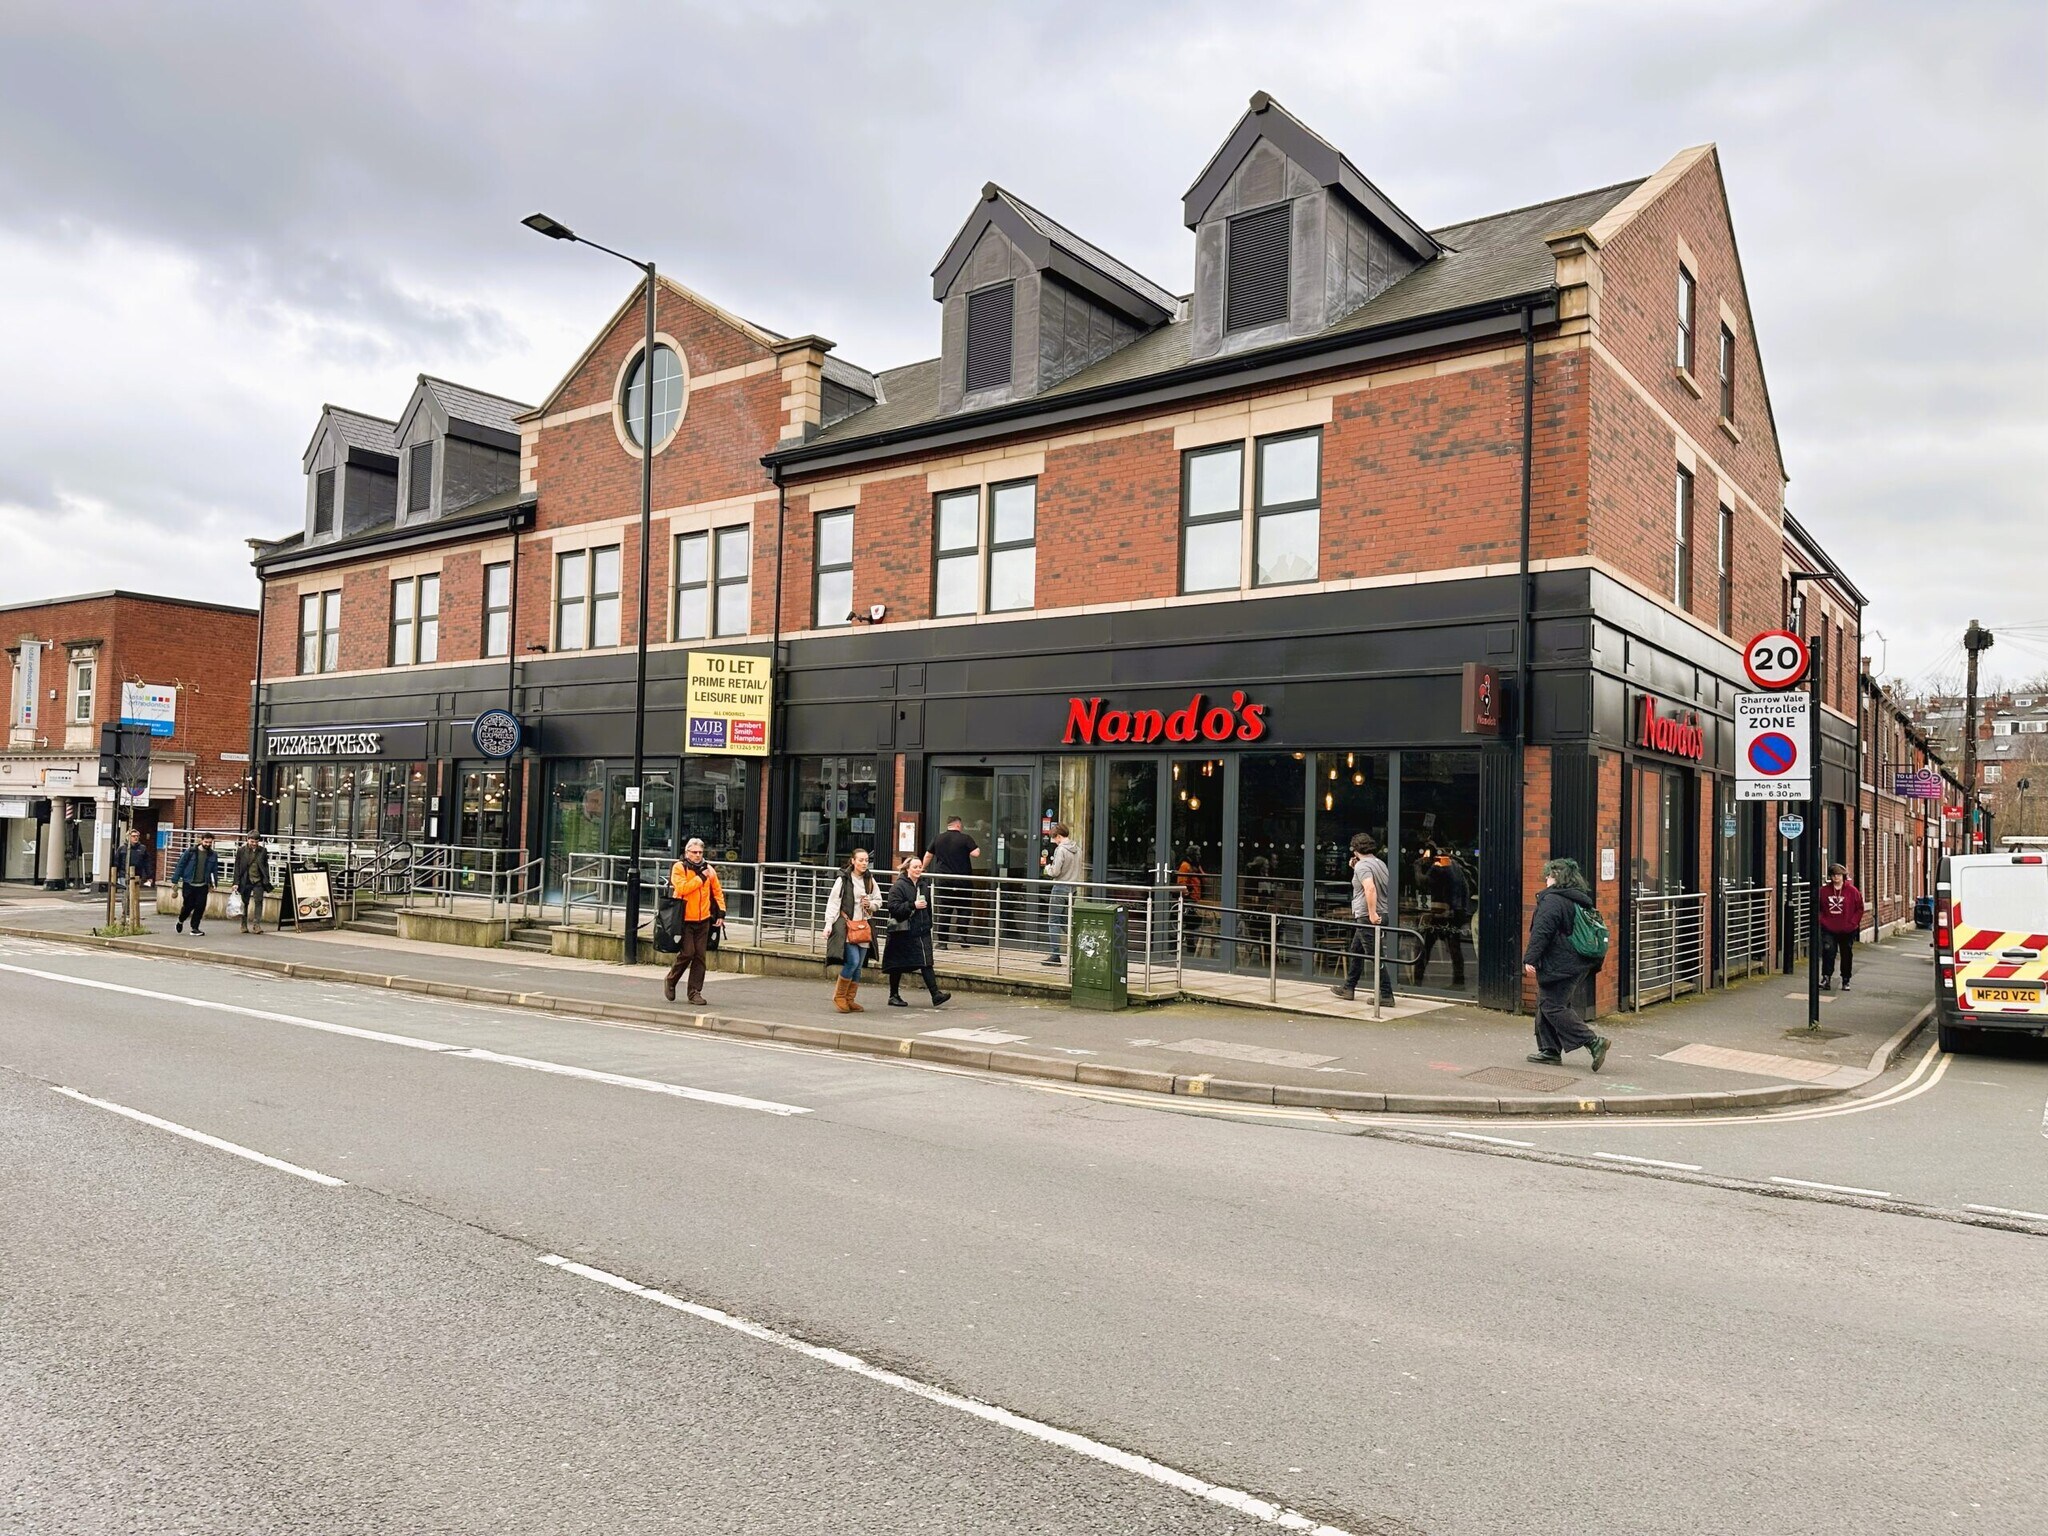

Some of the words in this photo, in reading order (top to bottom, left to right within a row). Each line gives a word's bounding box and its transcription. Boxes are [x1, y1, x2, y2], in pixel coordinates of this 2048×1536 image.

[1754, 646, 1799, 670] 20
[706, 658, 725, 672] TO
[729, 660, 754, 674] LET
[692, 676, 725, 688] PRIME
[728, 678, 767, 690] RETAIL/
[694, 691, 737, 703] LEISURE
[740, 694, 764, 704] UNIT
[1741, 696, 1780, 704] Sharrow
[1739, 704, 1806, 715] Controlled
[1061, 690, 1265, 744] Nando's
[1749, 717, 1796, 729] ZONE
[694, 720, 723, 735] MJB
[734, 721, 762, 729] Lambert
[1642, 693, 1704, 760] Nando's
[268, 733, 380, 755] PIZZAEXPRESS
[734, 735, 763, 743] Hampton
[1977, 990, 2009, 1000] MF20
[2012, 991, 2036, 1001] VZC
